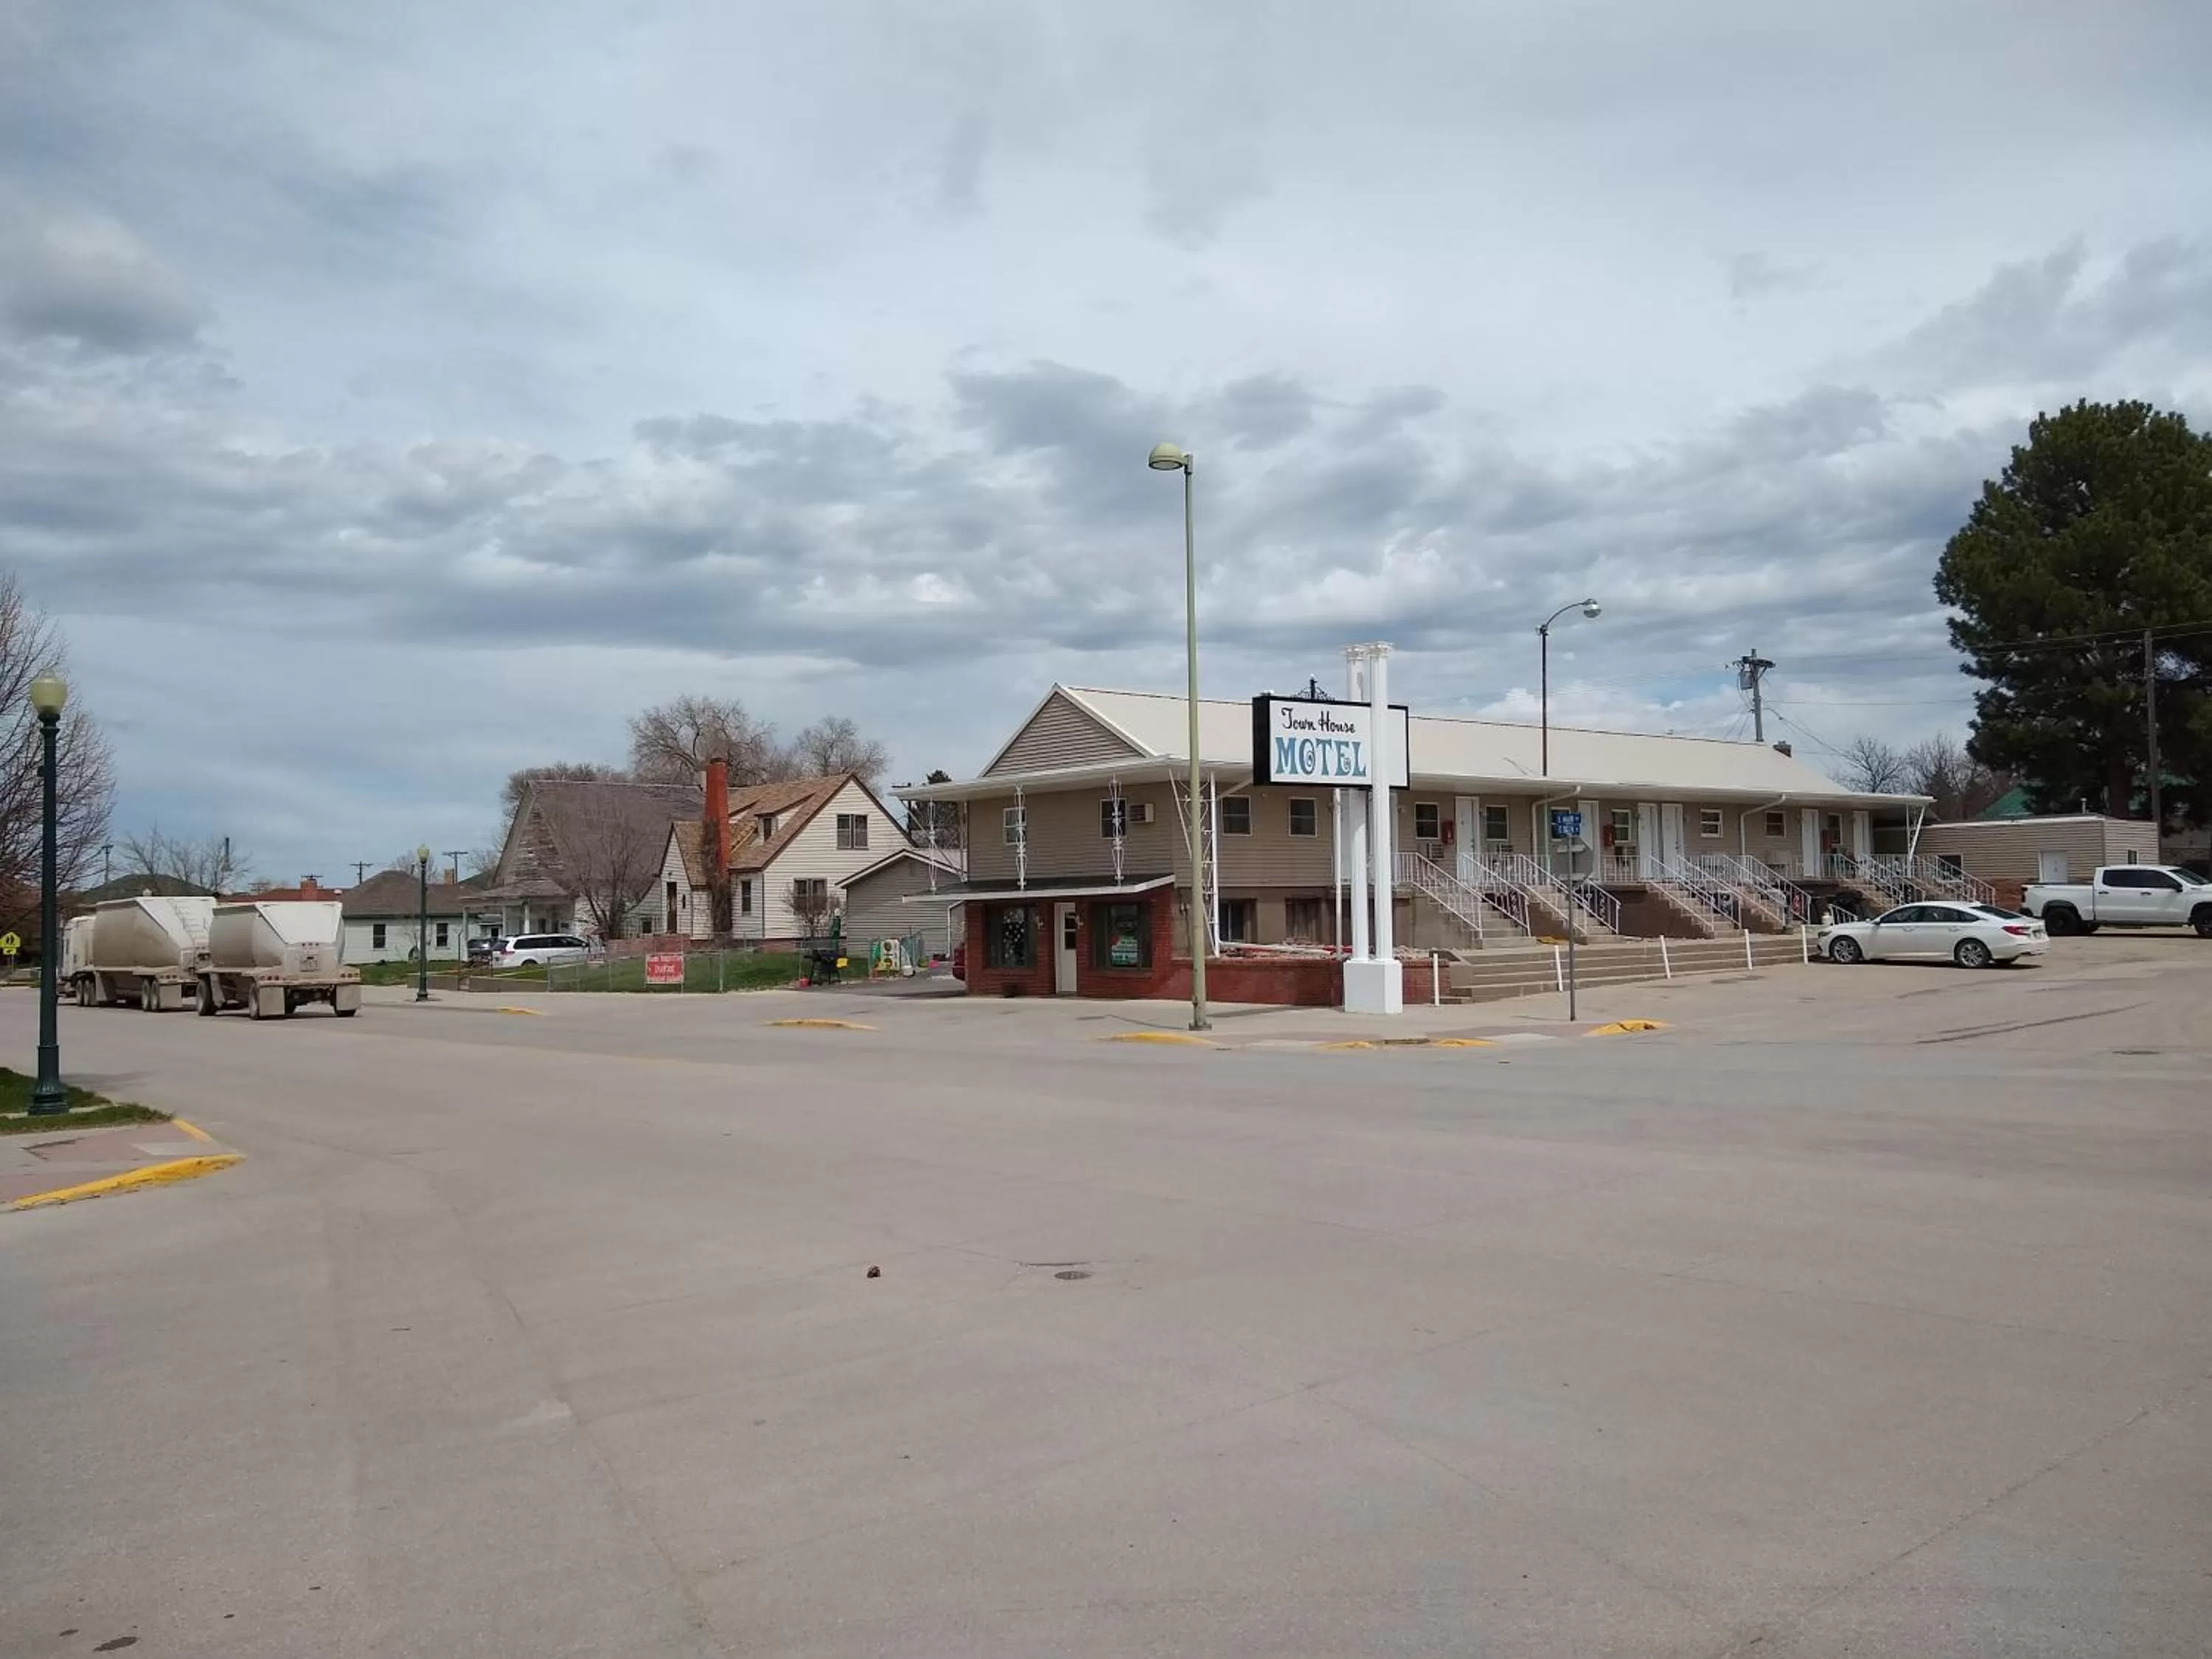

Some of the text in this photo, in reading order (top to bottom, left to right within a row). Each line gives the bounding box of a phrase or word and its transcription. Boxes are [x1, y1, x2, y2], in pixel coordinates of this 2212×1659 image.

[1281, 708, 1356, 734] Town House
[1275, 737, 1366, 776] MOTEL
